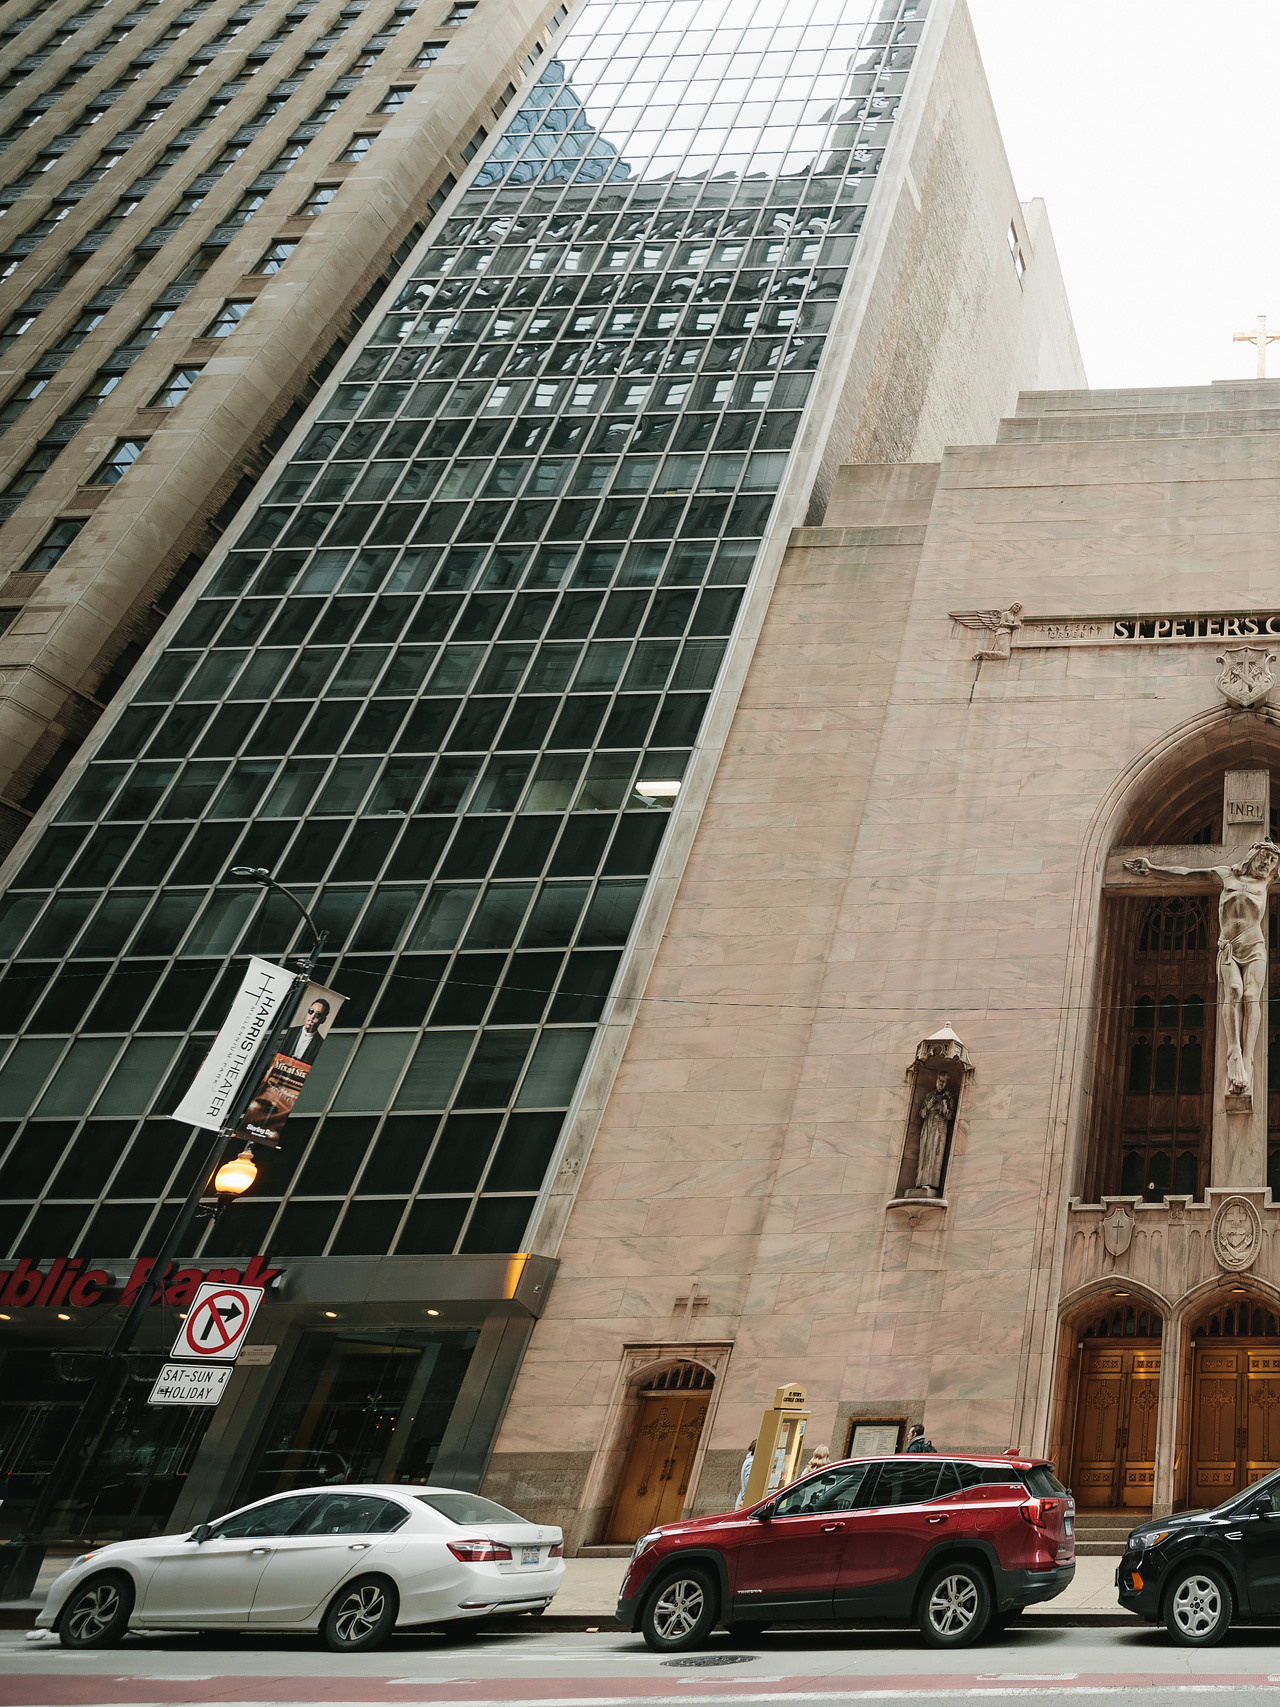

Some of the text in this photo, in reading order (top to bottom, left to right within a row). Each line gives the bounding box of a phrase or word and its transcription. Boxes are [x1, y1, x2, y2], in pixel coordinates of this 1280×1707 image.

[206, 996, 276, 1118] HARRIS THEATER
[0, 1257, 110, 1307] blic
[163, 1369, 227, 1384] SAT-SUN &
[163, 1386, 214, 1400] HOLIDAY
